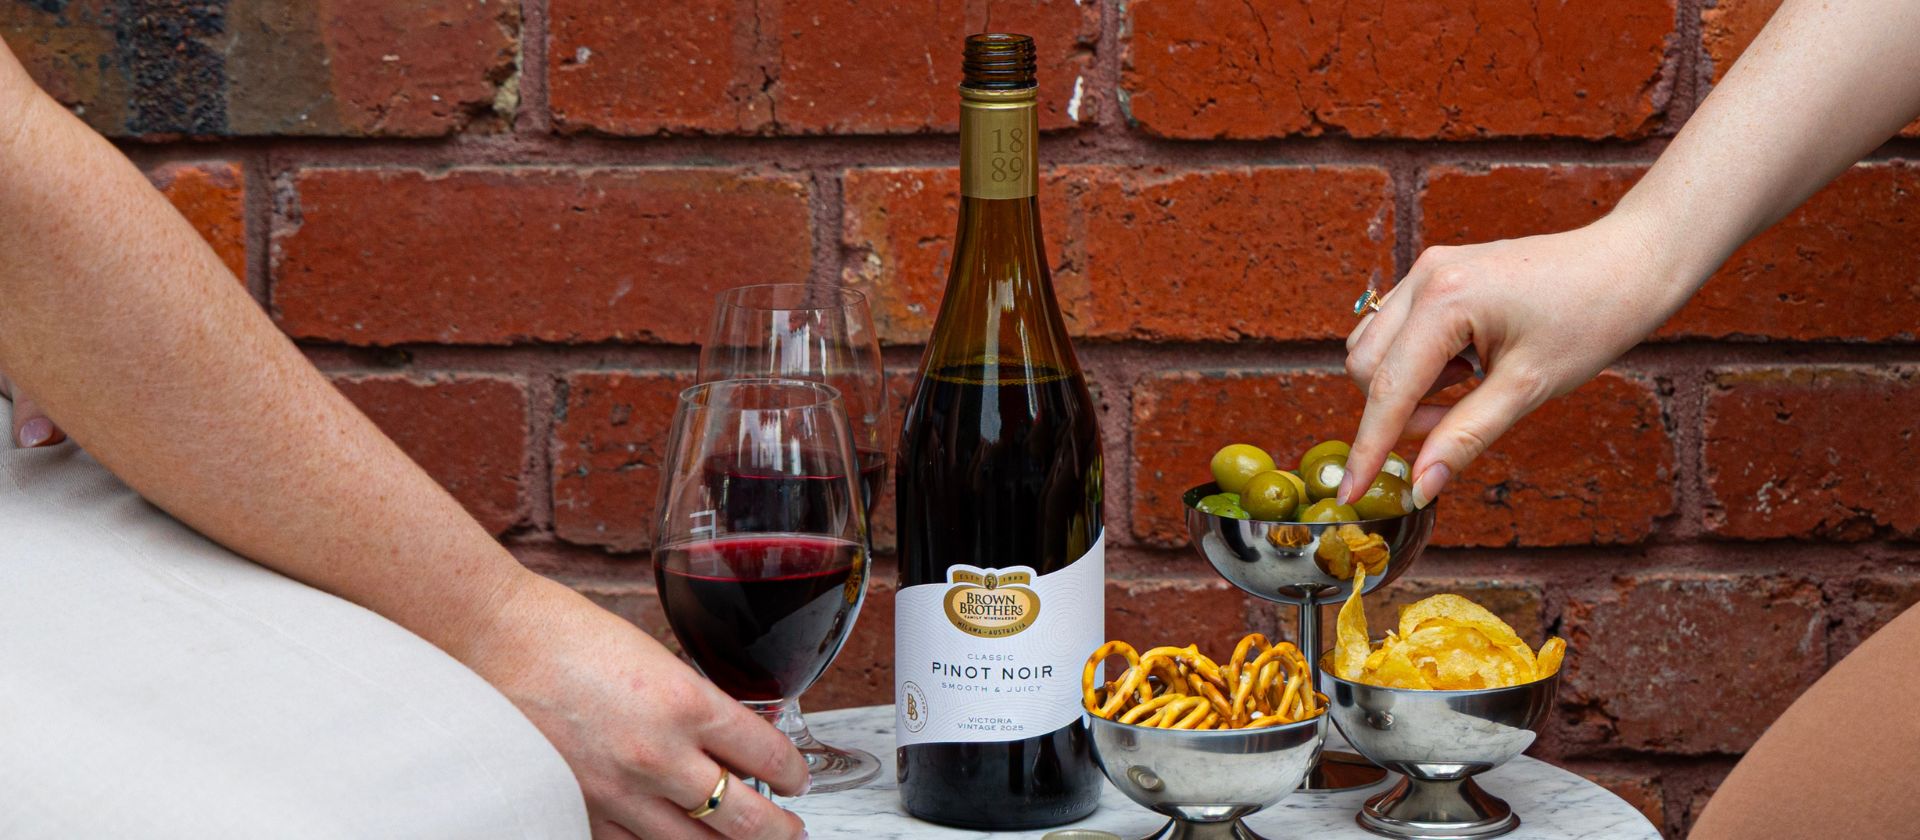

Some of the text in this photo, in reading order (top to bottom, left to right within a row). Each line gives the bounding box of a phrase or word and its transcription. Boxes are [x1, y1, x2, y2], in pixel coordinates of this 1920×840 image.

[992, 128, 1025, 154] 18
[991, 157, 1025, 183] 89
[966, 592, 1016, 605] BROWN
[960, 602, 1024, 616] BROTHERS
[989, 623, 1027, 636] AUSTRALIA
[967, 653, 1015, 662] CLASSIC
[932, 662, 1053, 680] PINOT NOIR
[941, 682, 988, 692] SMOOTH
[1007, 685, 1043, 693] JUICY
[968, 716, 1013, 724] VICTORIA
[957, 723, 997, 731] VINTAGE
